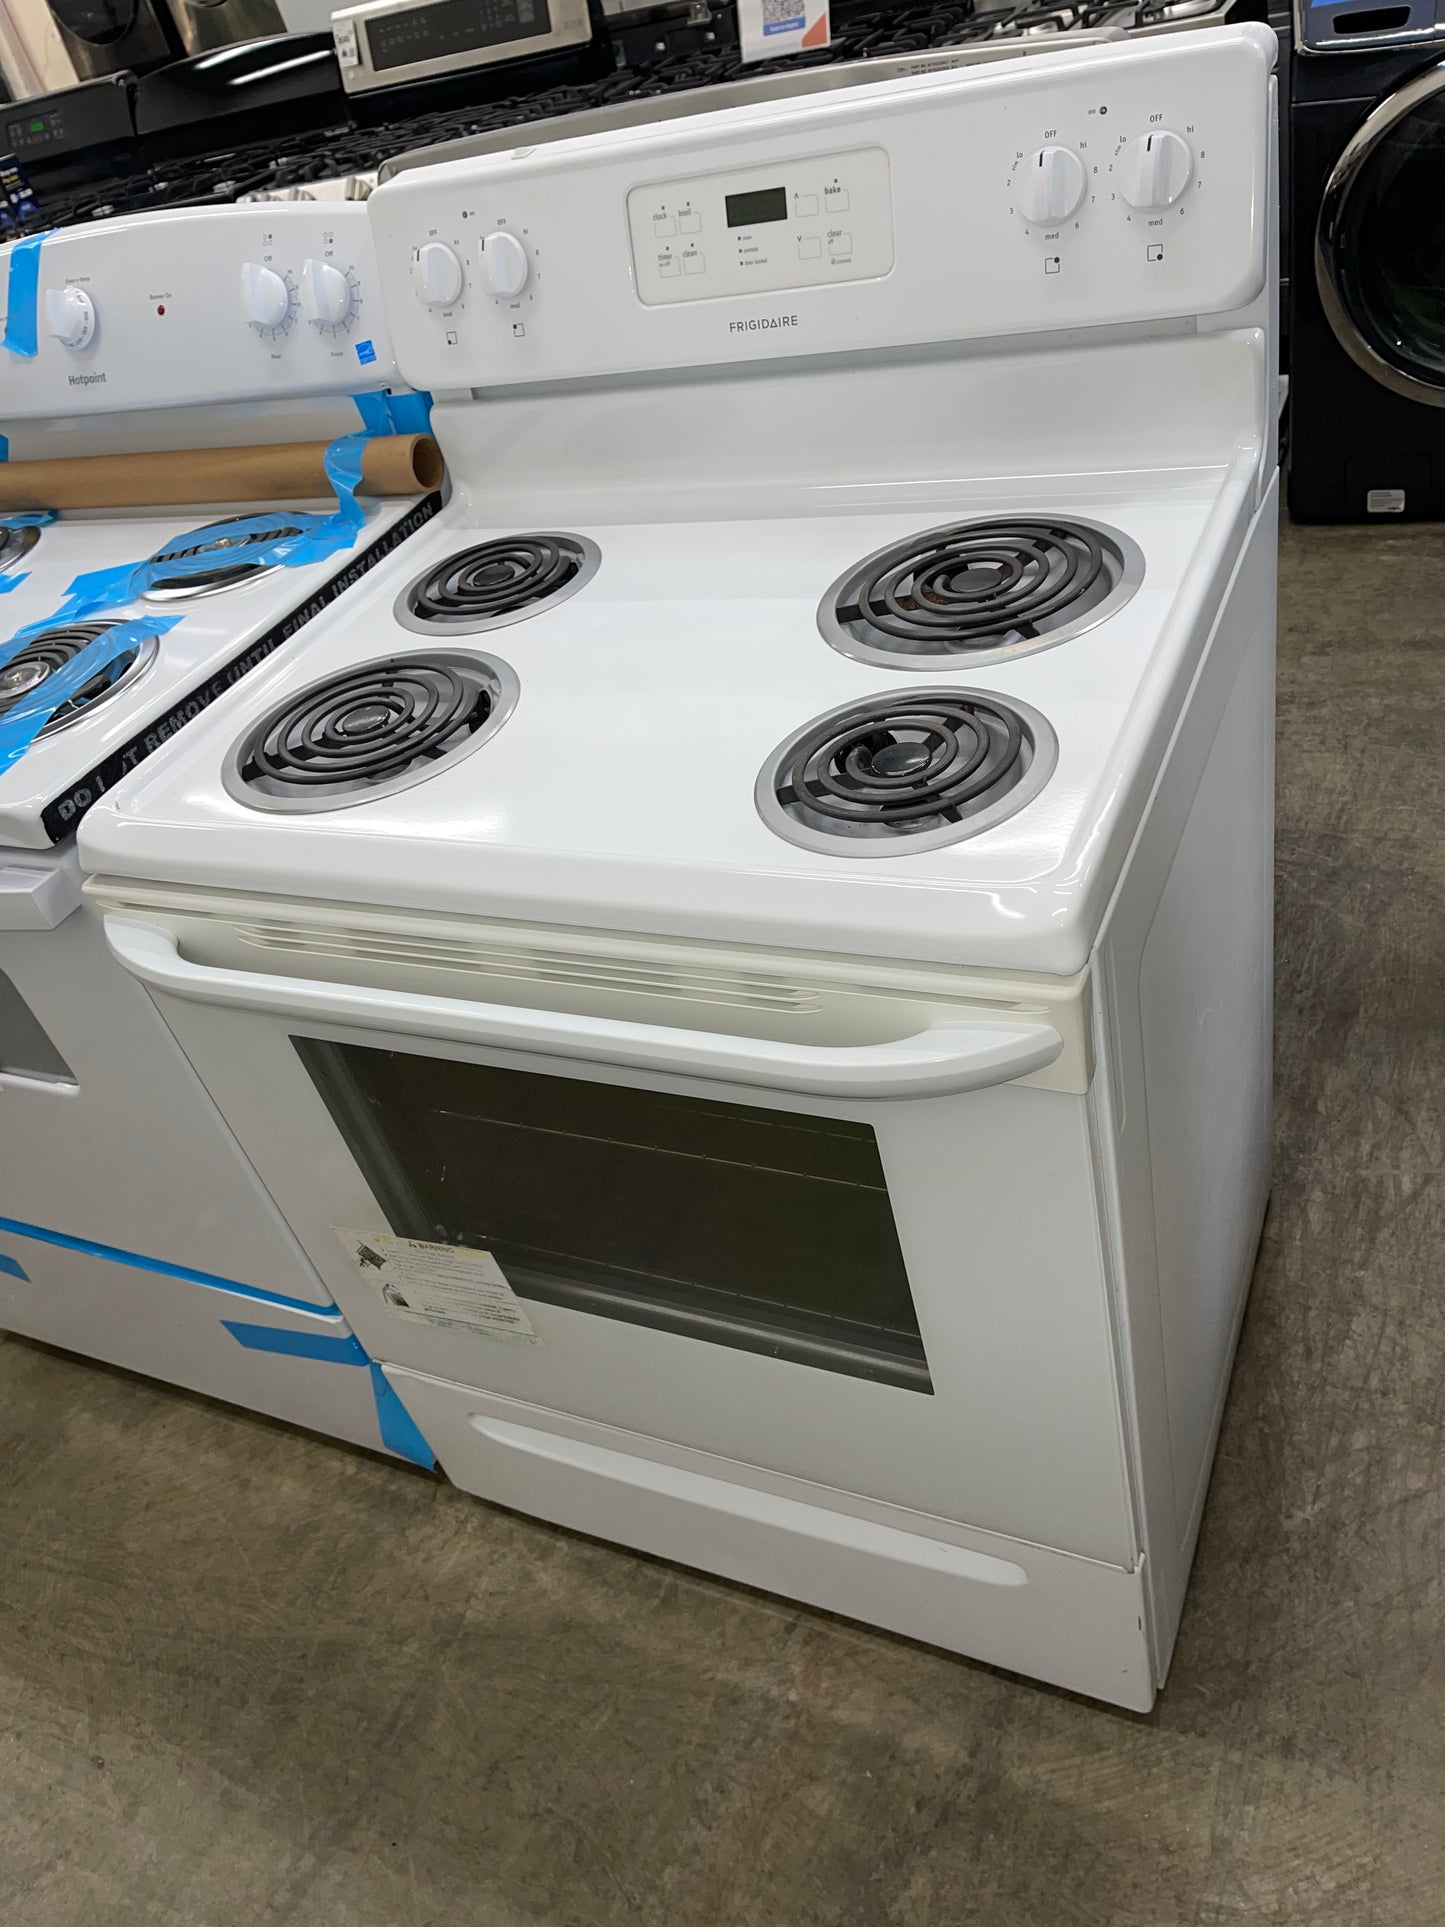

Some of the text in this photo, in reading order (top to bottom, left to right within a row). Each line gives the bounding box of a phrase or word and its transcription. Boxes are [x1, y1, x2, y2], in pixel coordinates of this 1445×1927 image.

[1150, 114, 1163, 122] OFF
[1186, 125, 1194, 134] hi
[1044, 130, 1058, 139] OFF
[1120, 135, 1126, 143] lo
[1080, 141, 1087, 149] hi
[1200, 151, 1205, 159] 8
[1093, 166, 1098, 174] 8
[1108, 164, 1113, 172] 2
[824, 186, 841, 195] bake
[1111, 193, 1115, 201] 3
[1148, 218, 1163, 227] med
[827, 230, 842, 238] clear
[1045, 232, 1059, 240] med
[729, 315, 798, 333] FRIGIDAIRE
[68, 372, 107, 386] Hotpoint
[58, 788, 92, 821] DO
[144, 680, 224, 751] REMOVE
[332, 502, 434, 596] INSTALLATION
